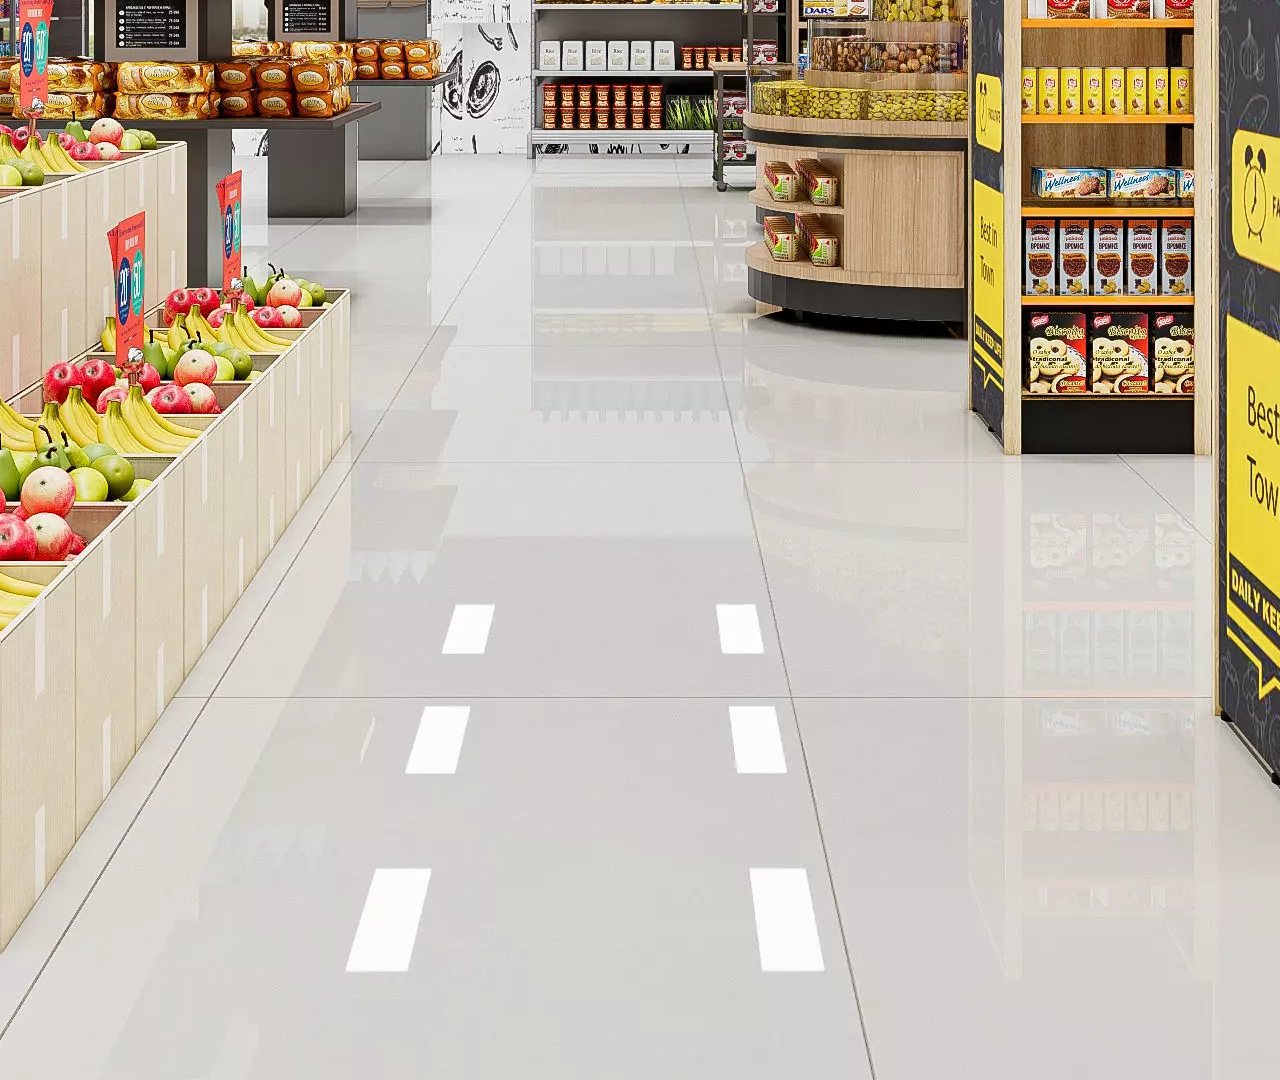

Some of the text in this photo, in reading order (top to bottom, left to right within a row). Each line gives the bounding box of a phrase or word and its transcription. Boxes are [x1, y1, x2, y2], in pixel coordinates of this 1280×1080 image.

[1044, 174, 1081, 191] Wellness
[1113, 174, 1150, 191] Wellness
[980, 216, 998, 249] Best in
[980, 255, 995, 287] Town
[1247, 384, 1280, 446] Best
[1231, 568, 1260, 613] DAILY
